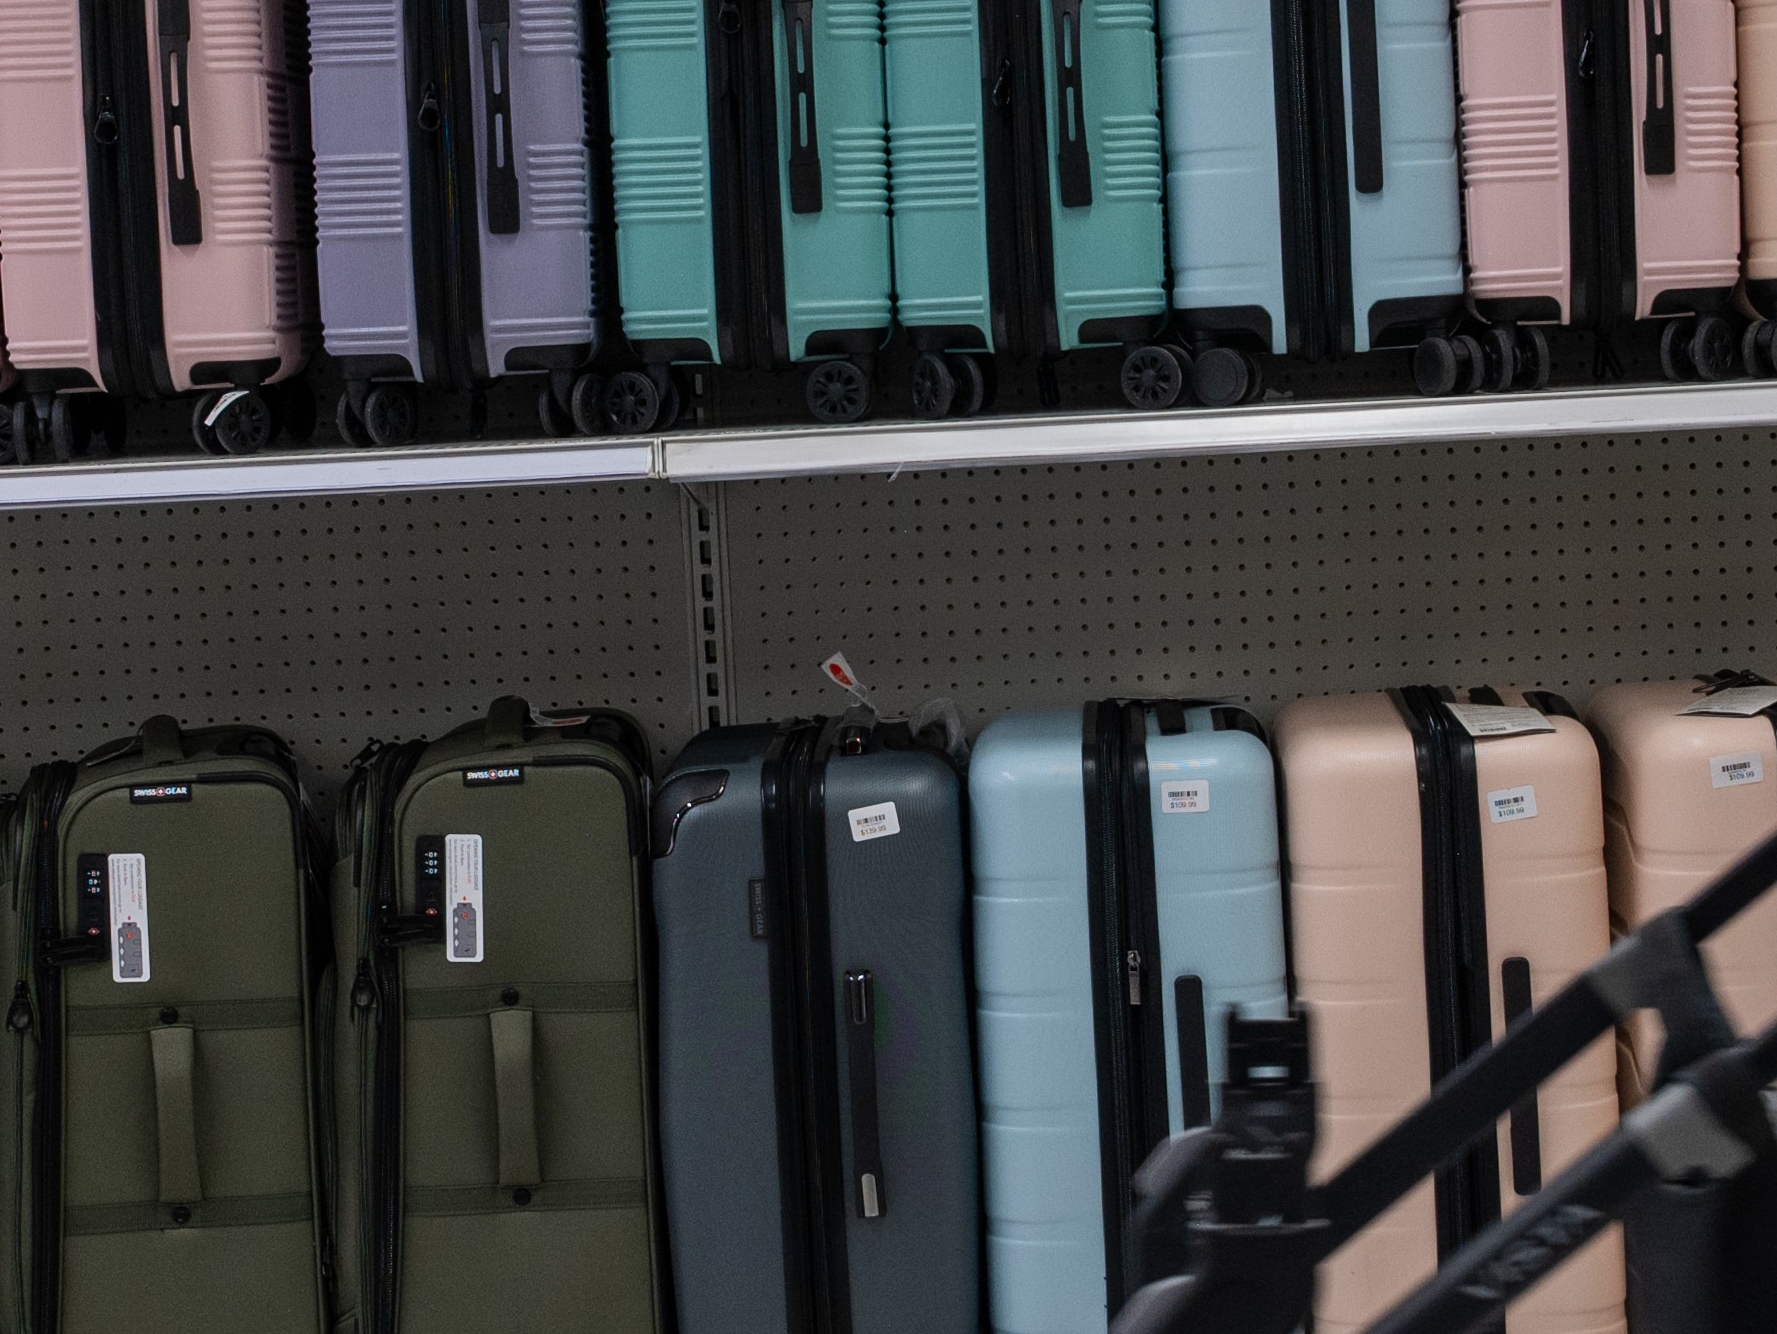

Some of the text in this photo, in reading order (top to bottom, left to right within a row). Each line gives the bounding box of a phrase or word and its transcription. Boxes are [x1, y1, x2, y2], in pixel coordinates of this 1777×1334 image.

[467, 769, 520, 780] SWISS GEAR
[134, 786, 187, 796] SWISS GEAR
[1170, 801, 1196, 809] $109.99
